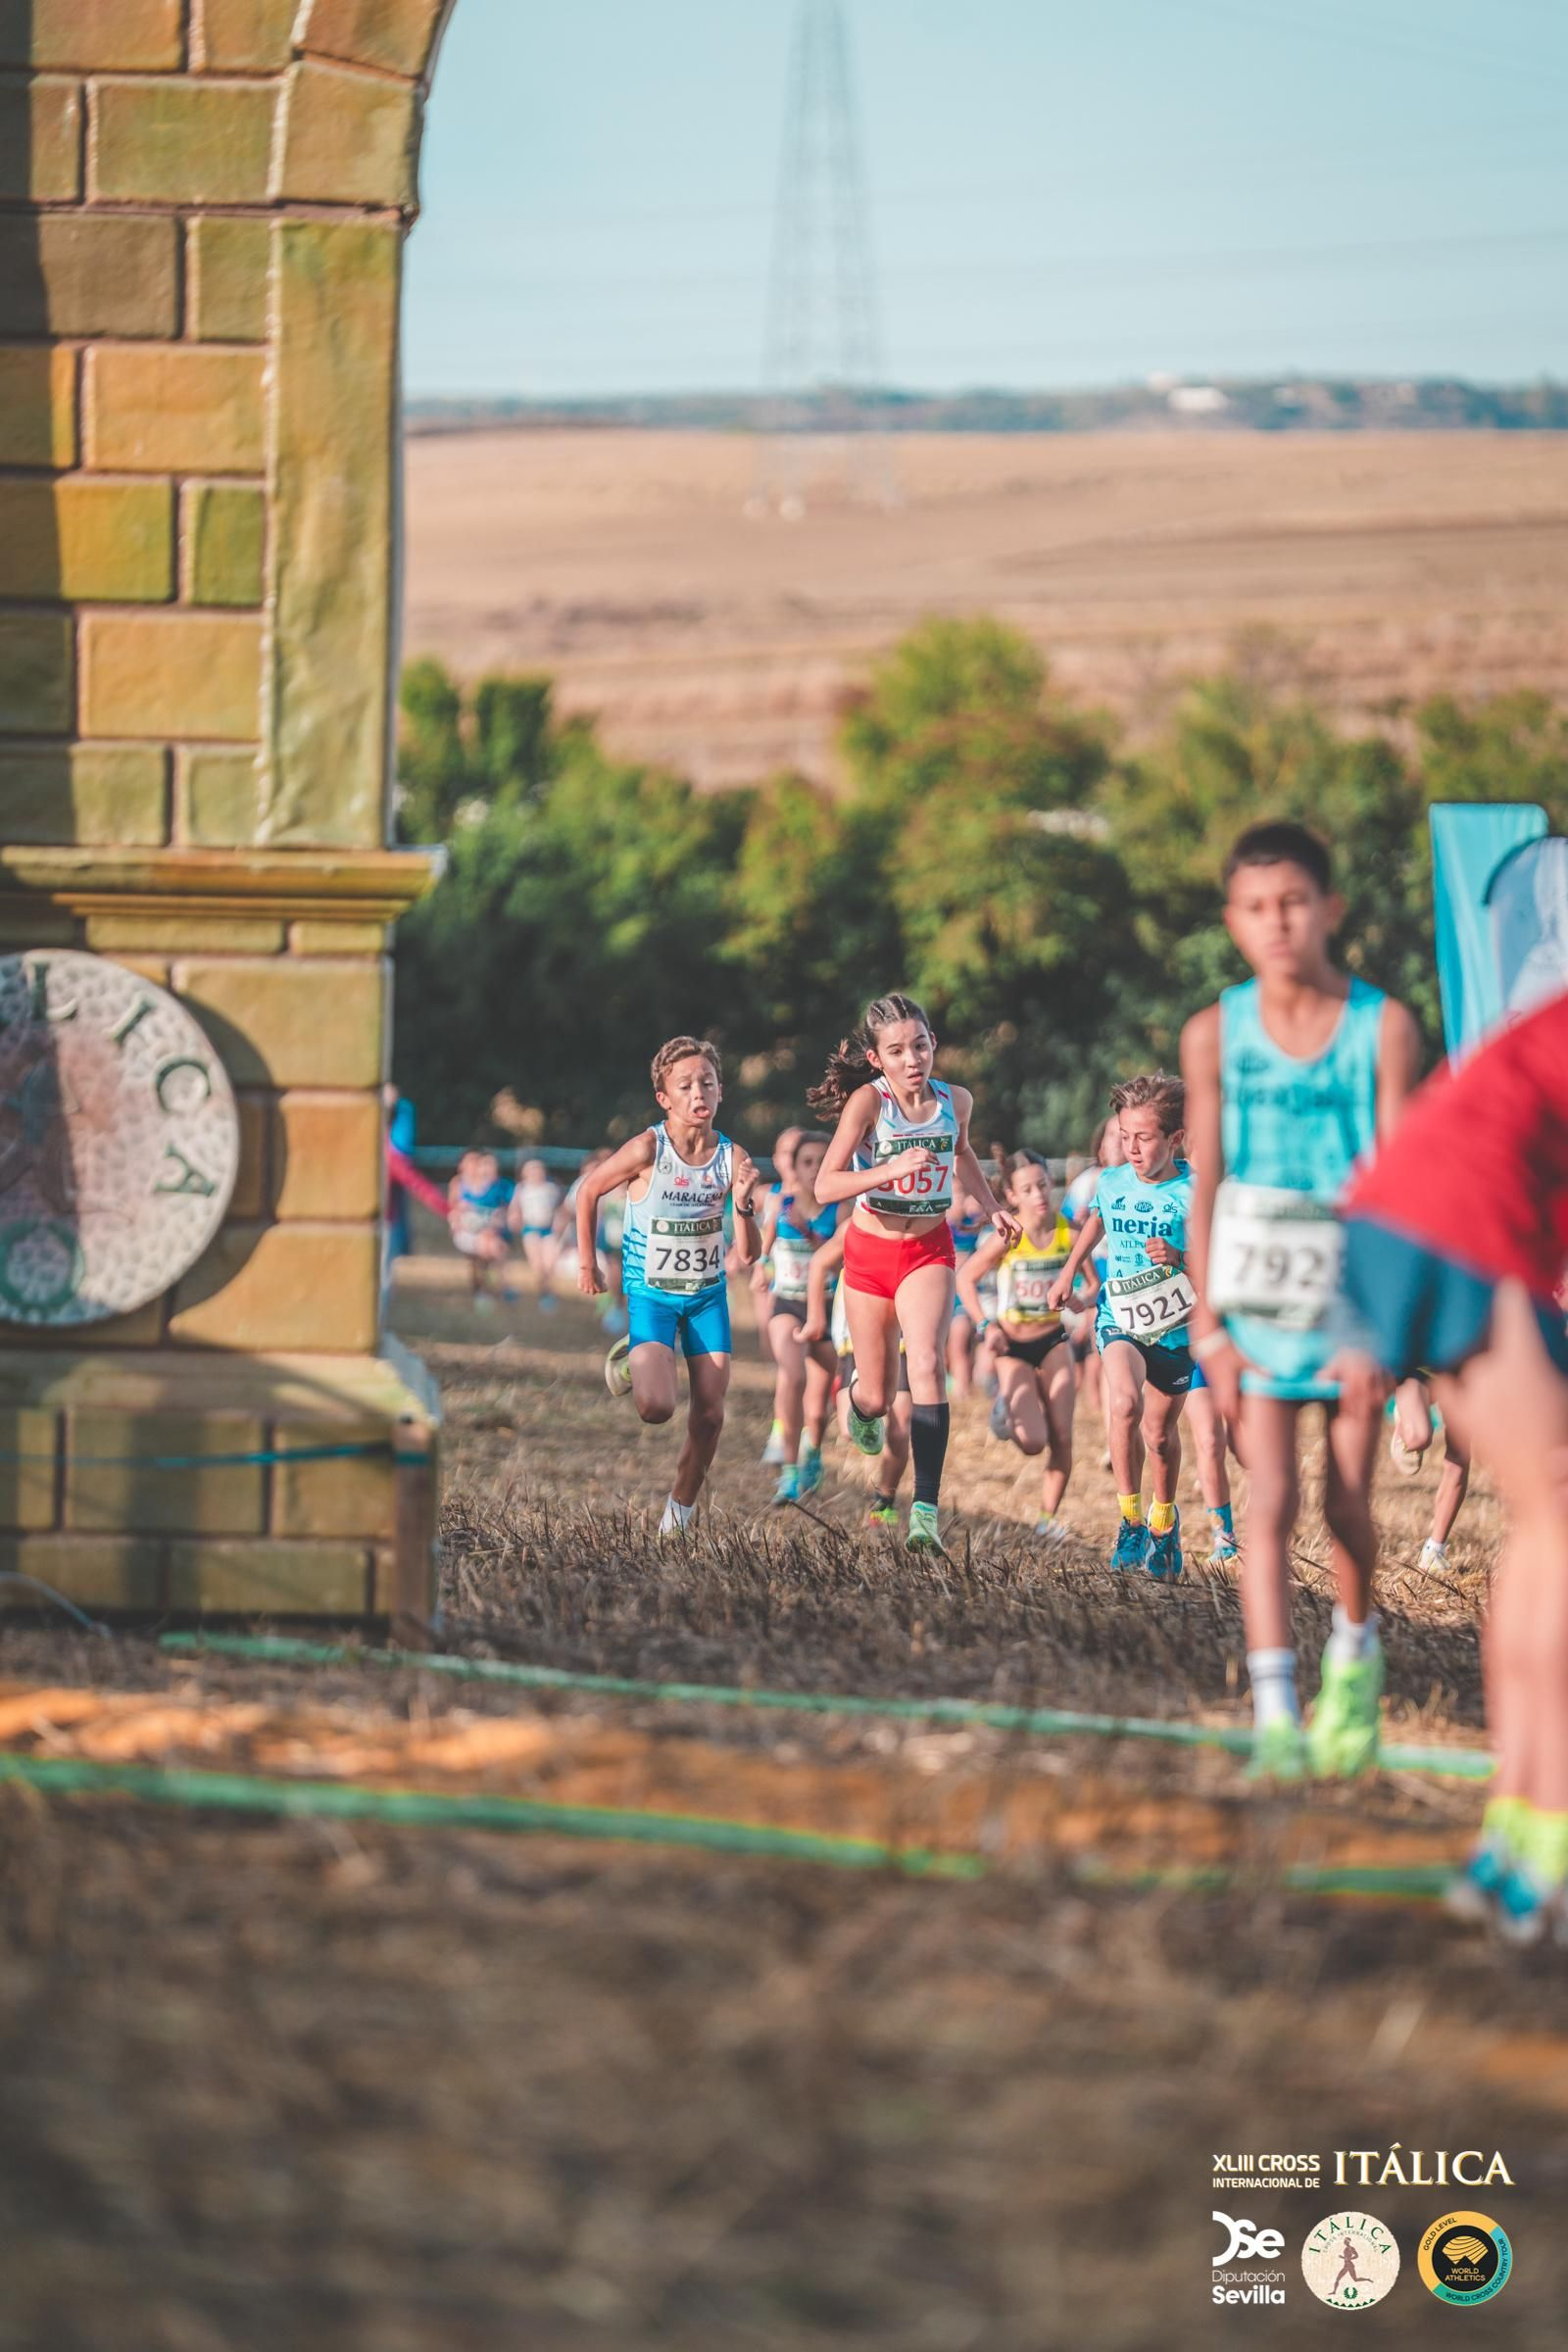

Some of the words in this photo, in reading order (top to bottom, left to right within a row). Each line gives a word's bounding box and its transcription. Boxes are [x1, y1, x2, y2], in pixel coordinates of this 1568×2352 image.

[0, 960, 217, 1198] LICA
[674, 1221, 710, 1232] ITÁLICA
[1111, 1216, 1173, 1238] nerja
[656, 1245, 720, 1272] 7834
[1233, 1243, 1325, 1290] 792
[1120, 1287, 1193, 1329] 7921
